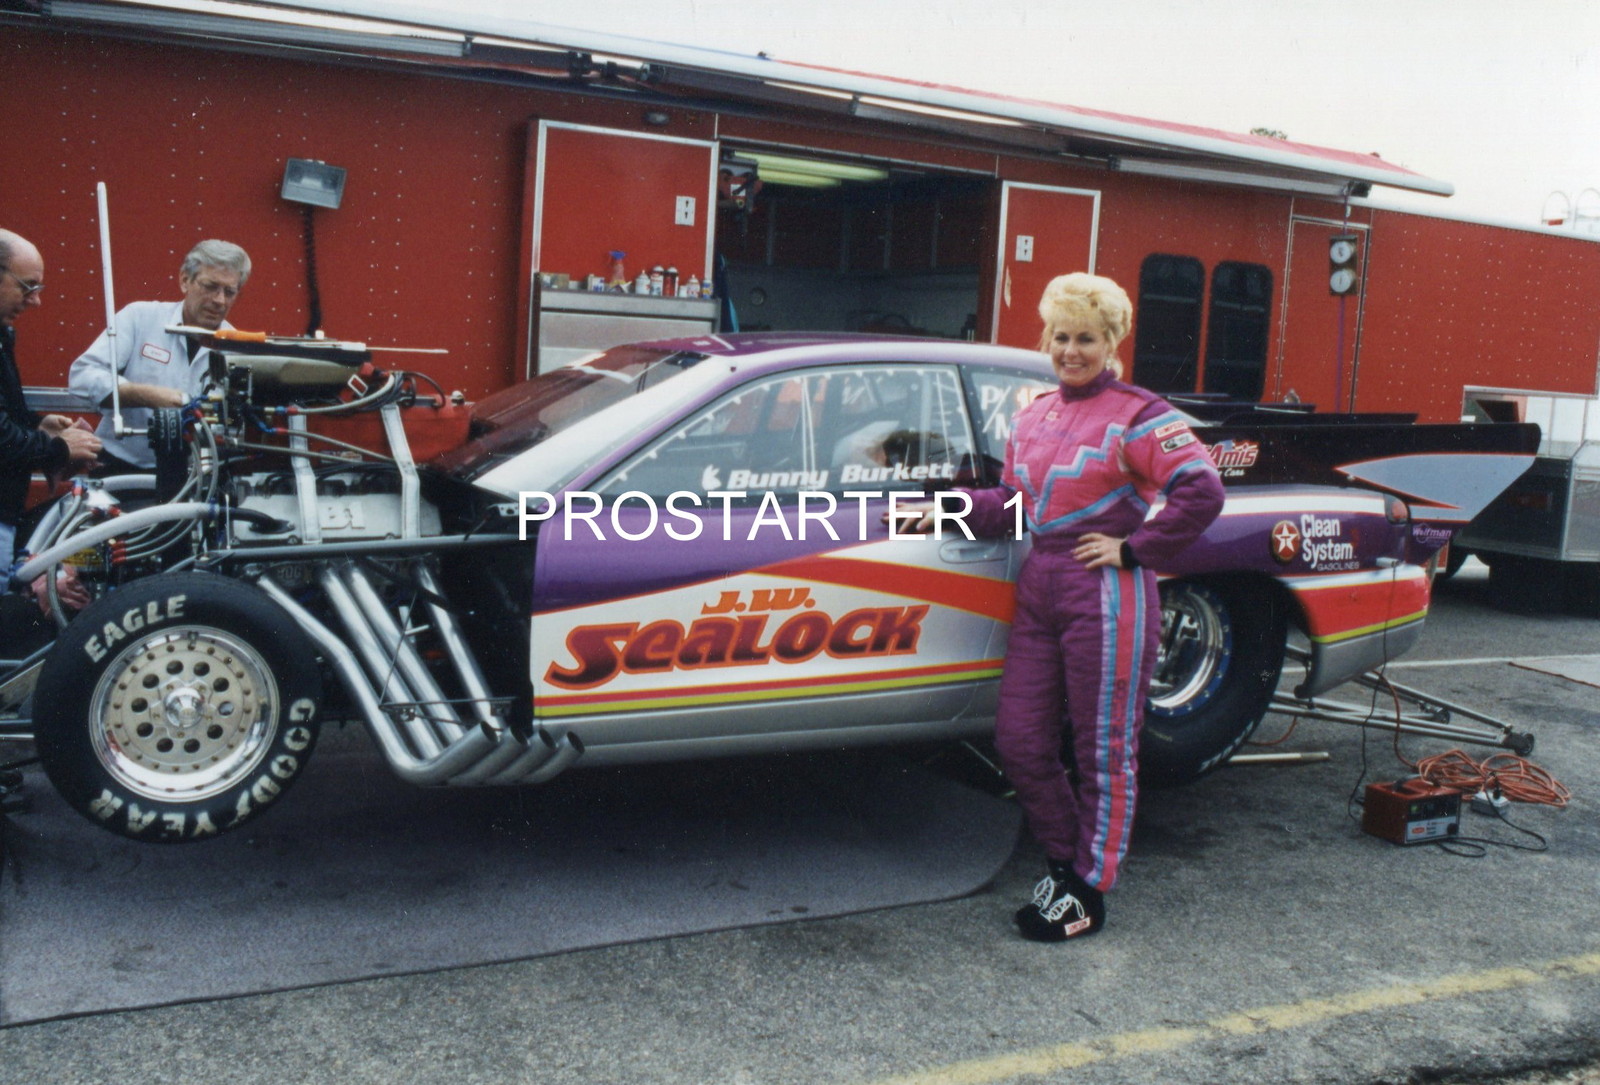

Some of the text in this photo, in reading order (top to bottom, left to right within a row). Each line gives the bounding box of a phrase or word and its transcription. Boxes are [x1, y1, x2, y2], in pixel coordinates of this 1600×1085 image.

[727, 463, 955, 490] Bunny Burkett
[1301, 514, 1341, 538] Clean
[1302, 539, 1354, 569] System
[1317, 561, 1360, 572] GASOLINES
[84, 594, 187, 663] EAGLE
